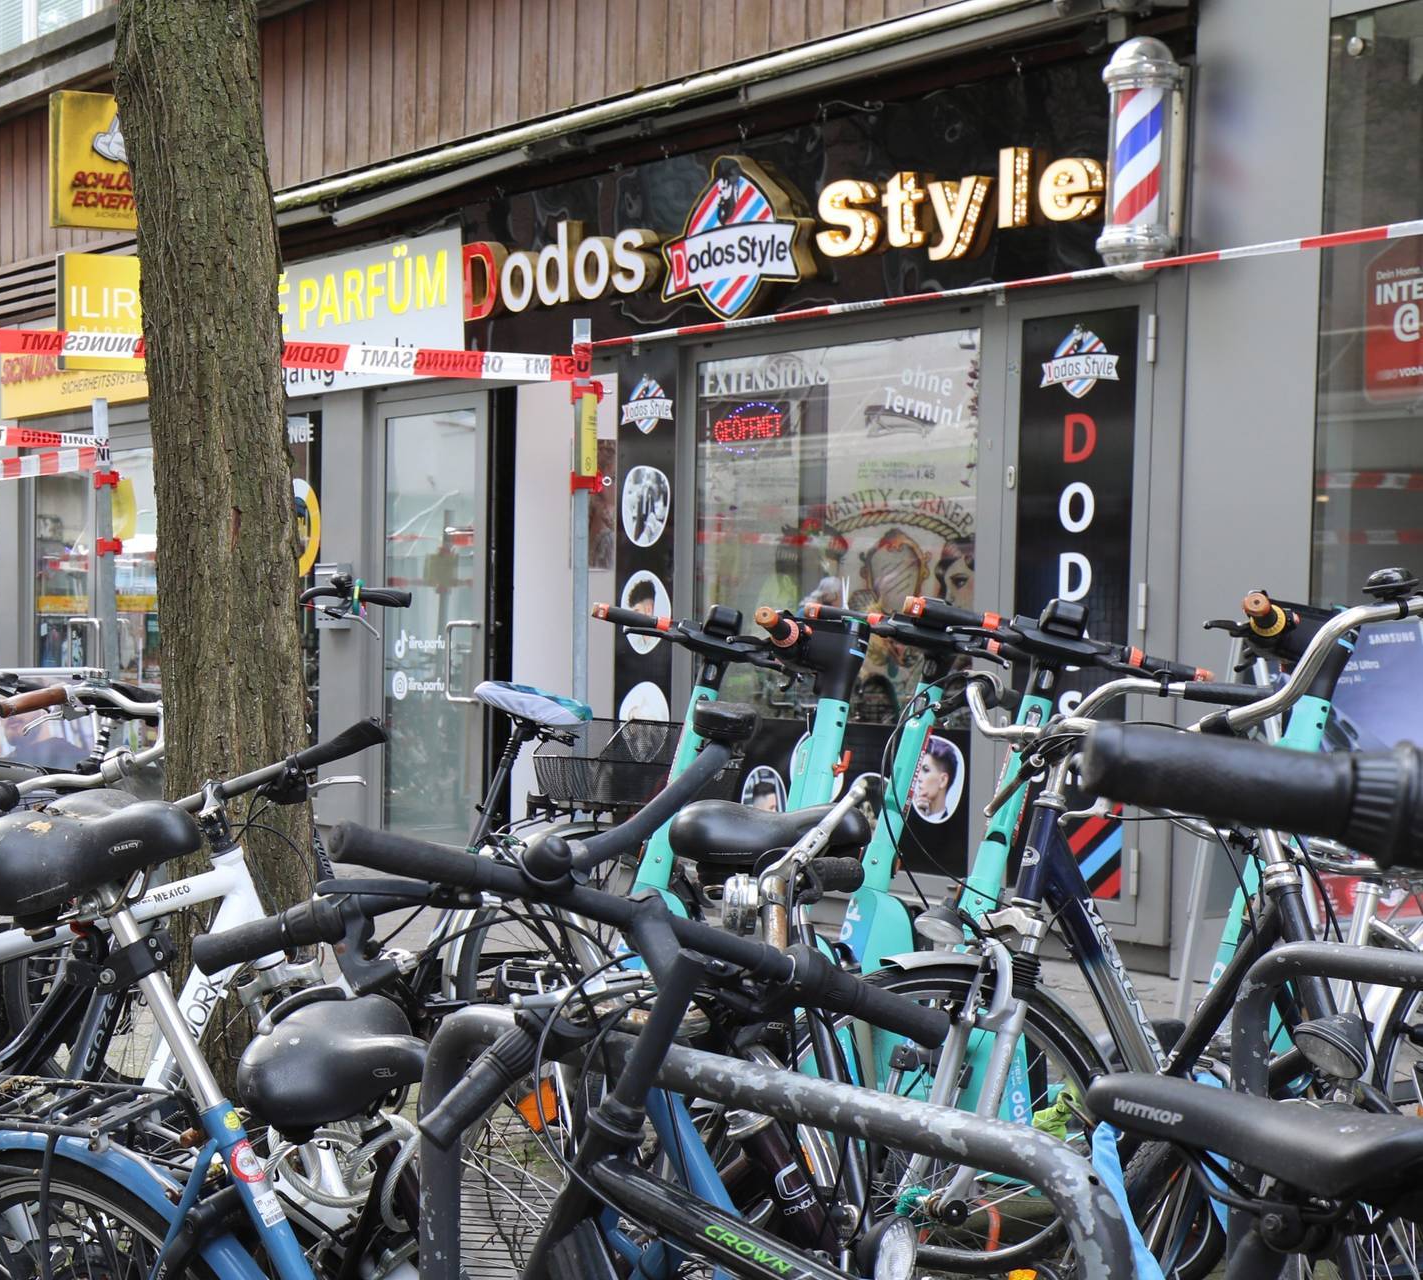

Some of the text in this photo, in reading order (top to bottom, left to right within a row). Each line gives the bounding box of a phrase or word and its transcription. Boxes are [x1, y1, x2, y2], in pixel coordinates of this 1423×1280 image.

[463, 219, 649, 323] Dodos
[673, 234, 788, 287] Dodos Style
[298, 243, 449, 332] PARFÜM
[704, 362, 830, 397] EXTENSIONS
[901, 365, 953, 397] ohne
[884, 386, 964, 428] Termin!
[714, 413, 783, 442] GEÖFFNET
[1368, 631, 1416, 646] SAMSUNG
[152, 884, 192, 904] MEXICO
[1113, 1097, 1184, 1126] WITTKOP
[704, 1224, 794, 1276] CROWN
